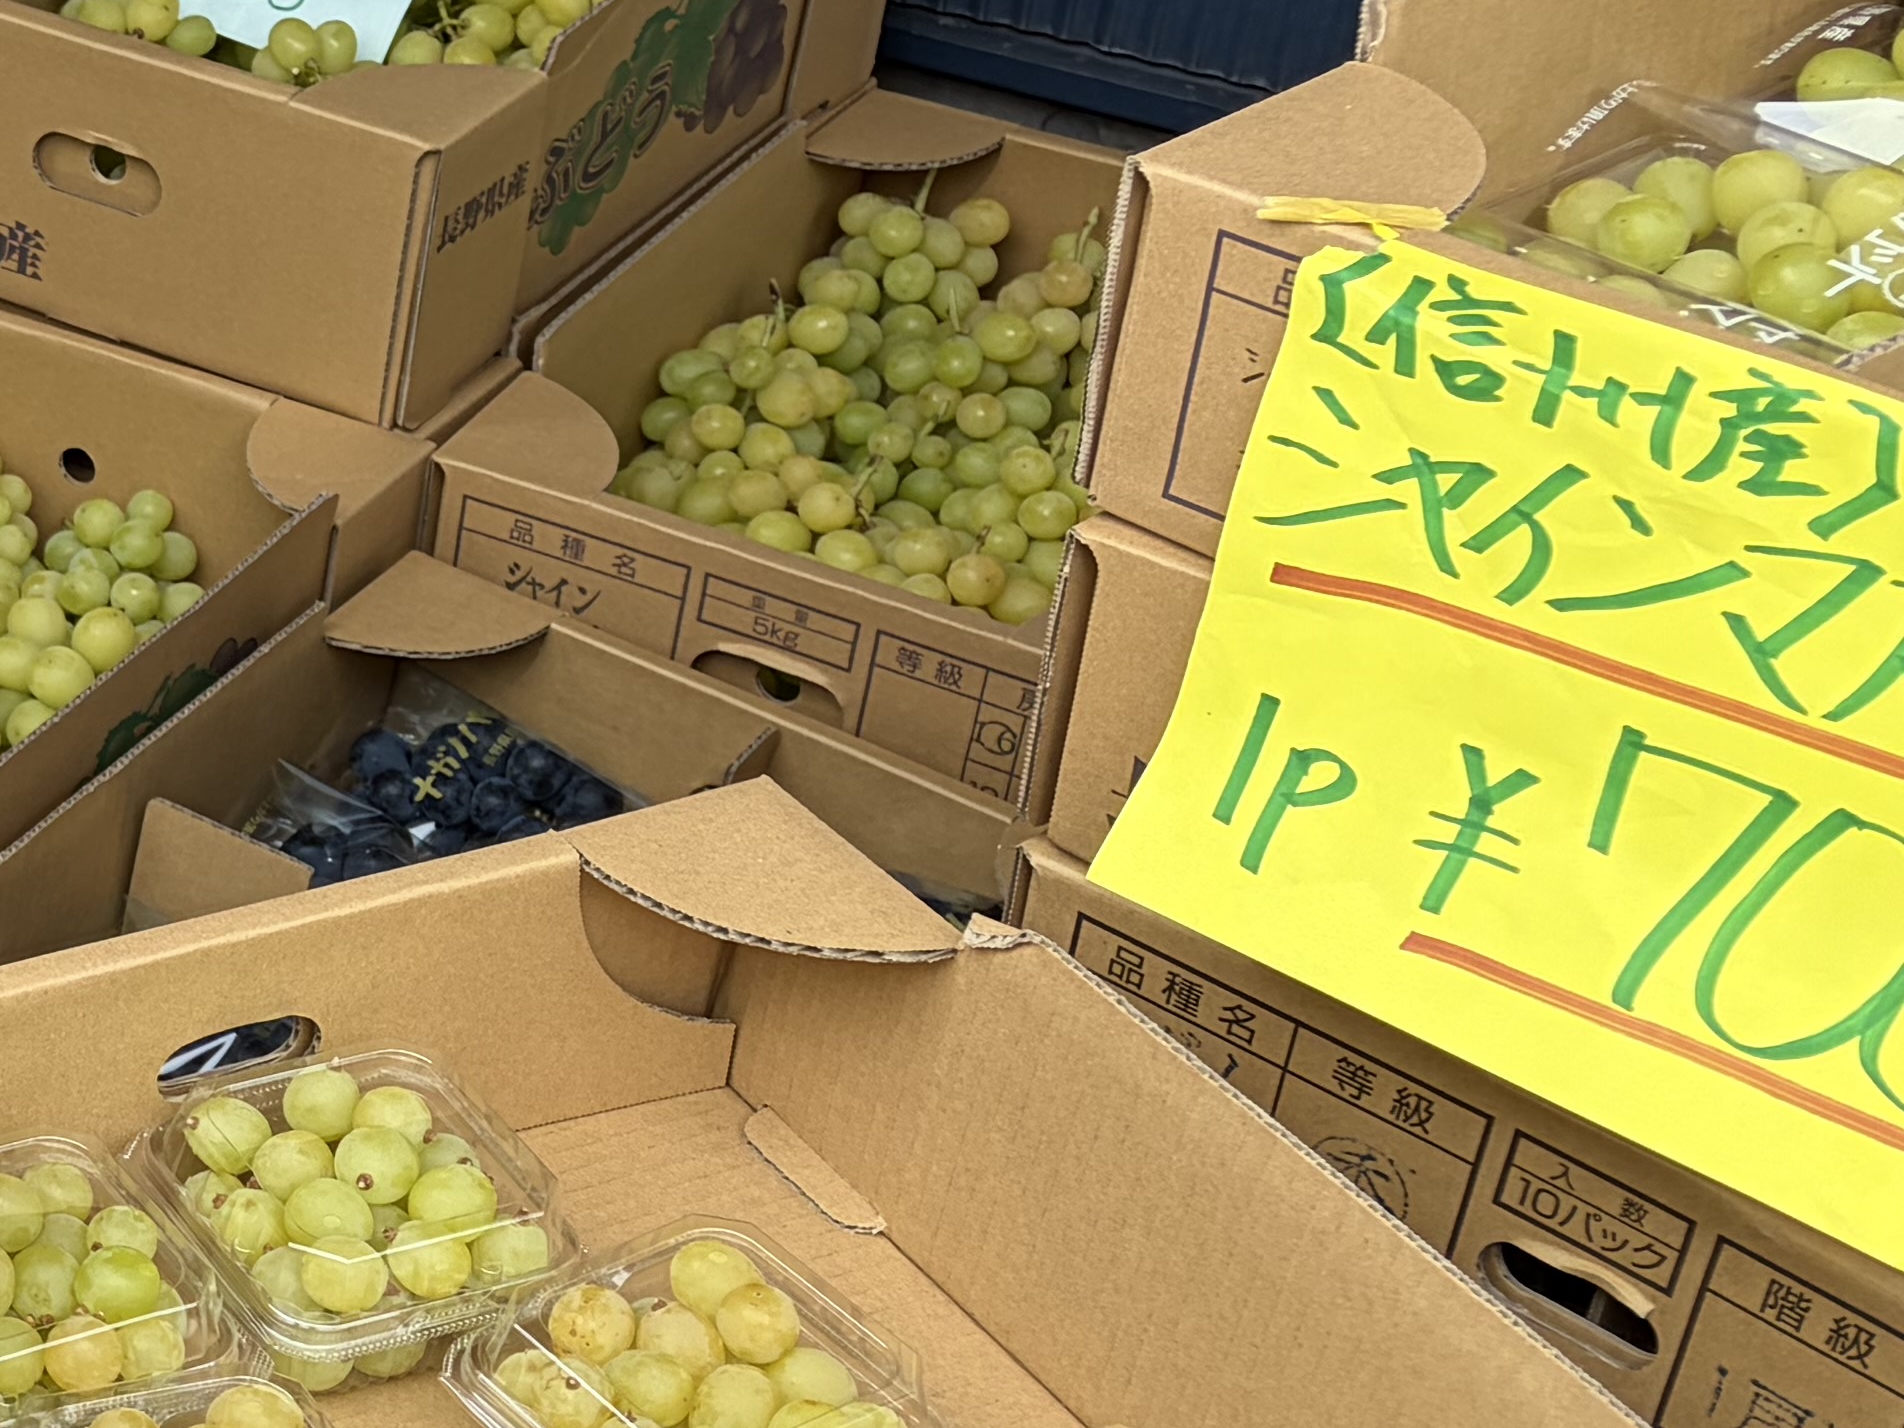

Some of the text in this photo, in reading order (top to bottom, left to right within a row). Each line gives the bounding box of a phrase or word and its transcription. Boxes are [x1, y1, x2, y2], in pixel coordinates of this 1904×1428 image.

[530, 59, 672, 229] ぶどう
[436, 159, 531, 253] 長野県産
[504, 562, 601, 615] シャイン
[510, 518, 638, 579] 品種名
[1254, 386, 1904, 721] シャインマ
[753, 616, 800, 651] 5kg
[896, 646, 963, 689] 等級
[1413, 725, 1904, 1113] ¥70
[1107, 947, 1258, 1045] 品種名
[1332, 1055, 1437, 1133] 等級
[1516, 1177, 1669, 1272] 10パック
[1549, 1162, 1647, 1227] 入数
[1760, 1279, 1876, 1369] 階級
